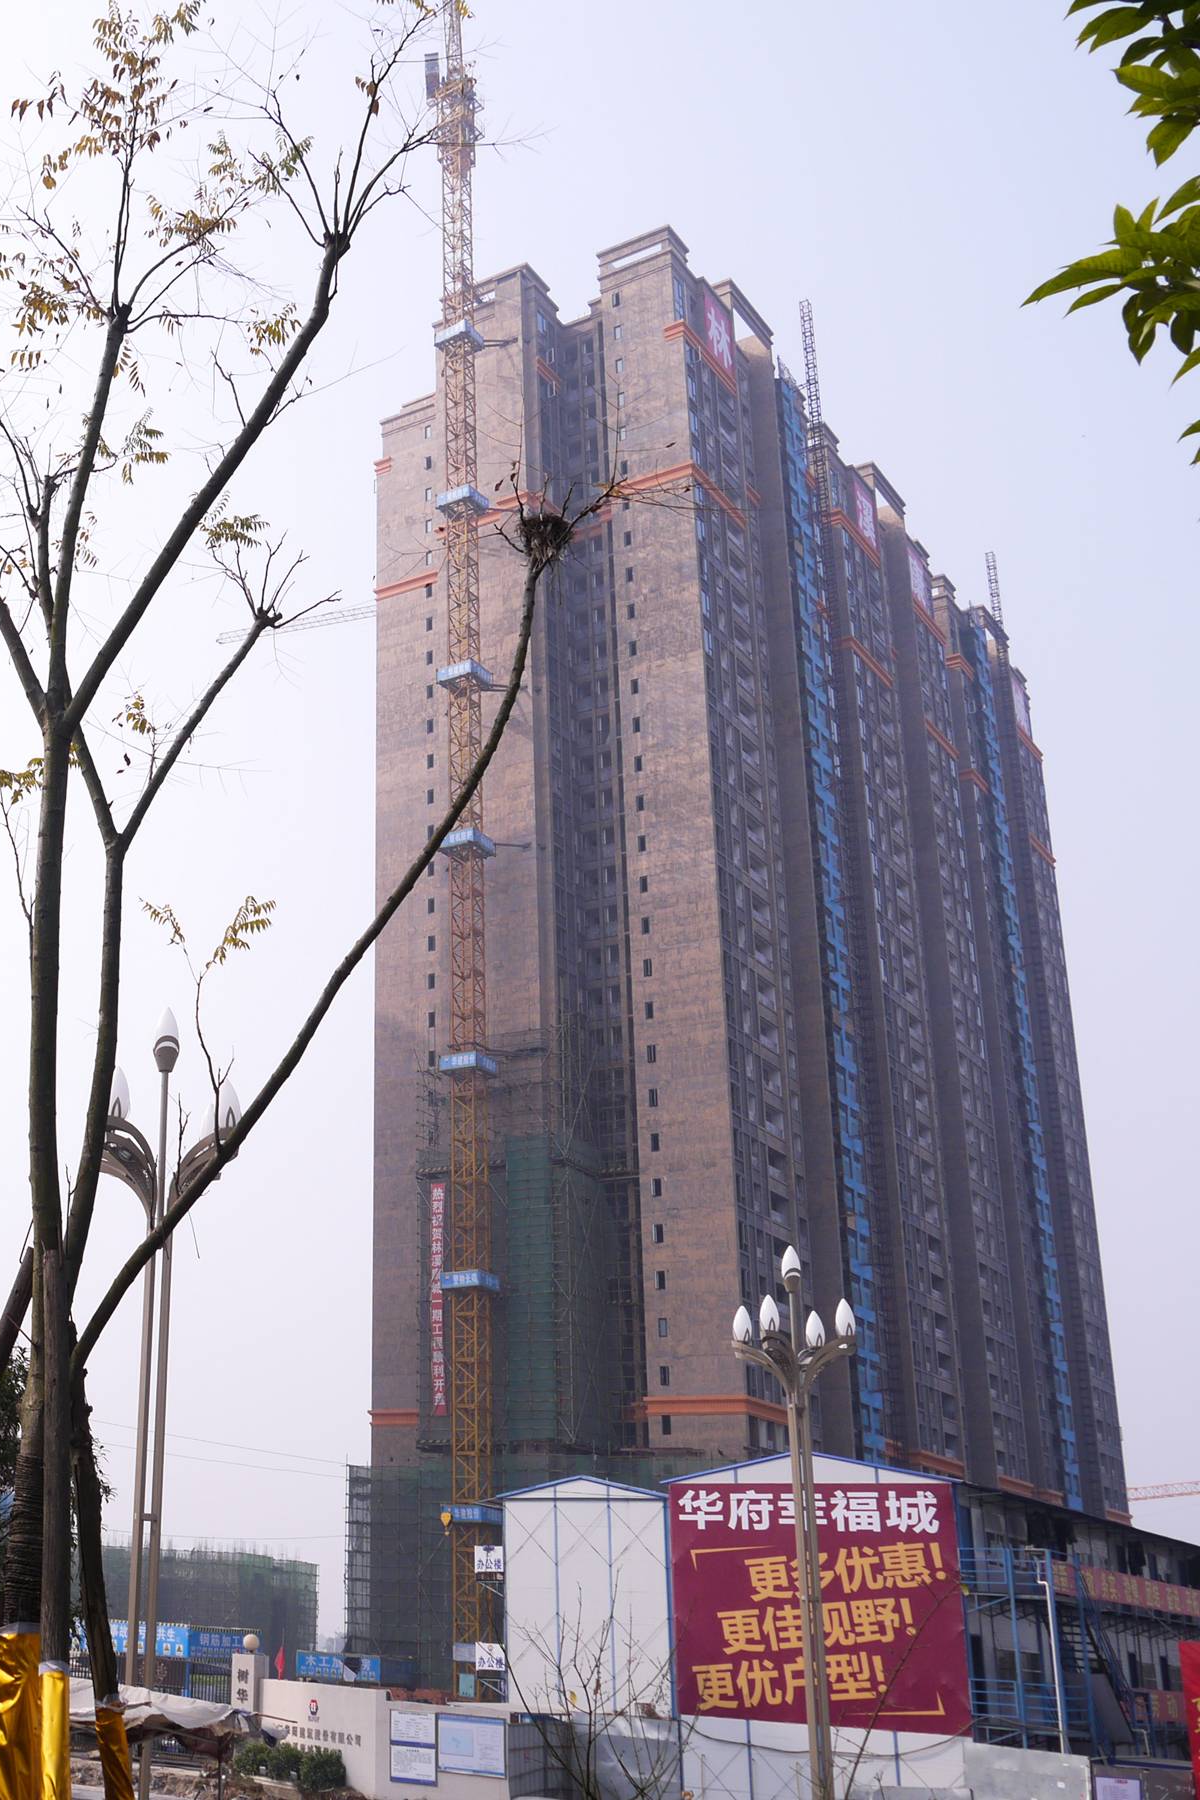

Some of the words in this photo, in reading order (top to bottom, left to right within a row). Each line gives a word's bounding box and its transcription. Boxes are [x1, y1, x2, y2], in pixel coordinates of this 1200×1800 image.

[707, 308, 733, 369] 林
[678, 1490, 941, 1534] 华府幸福城
[477, 1559, 502, 1570] 办公楼
